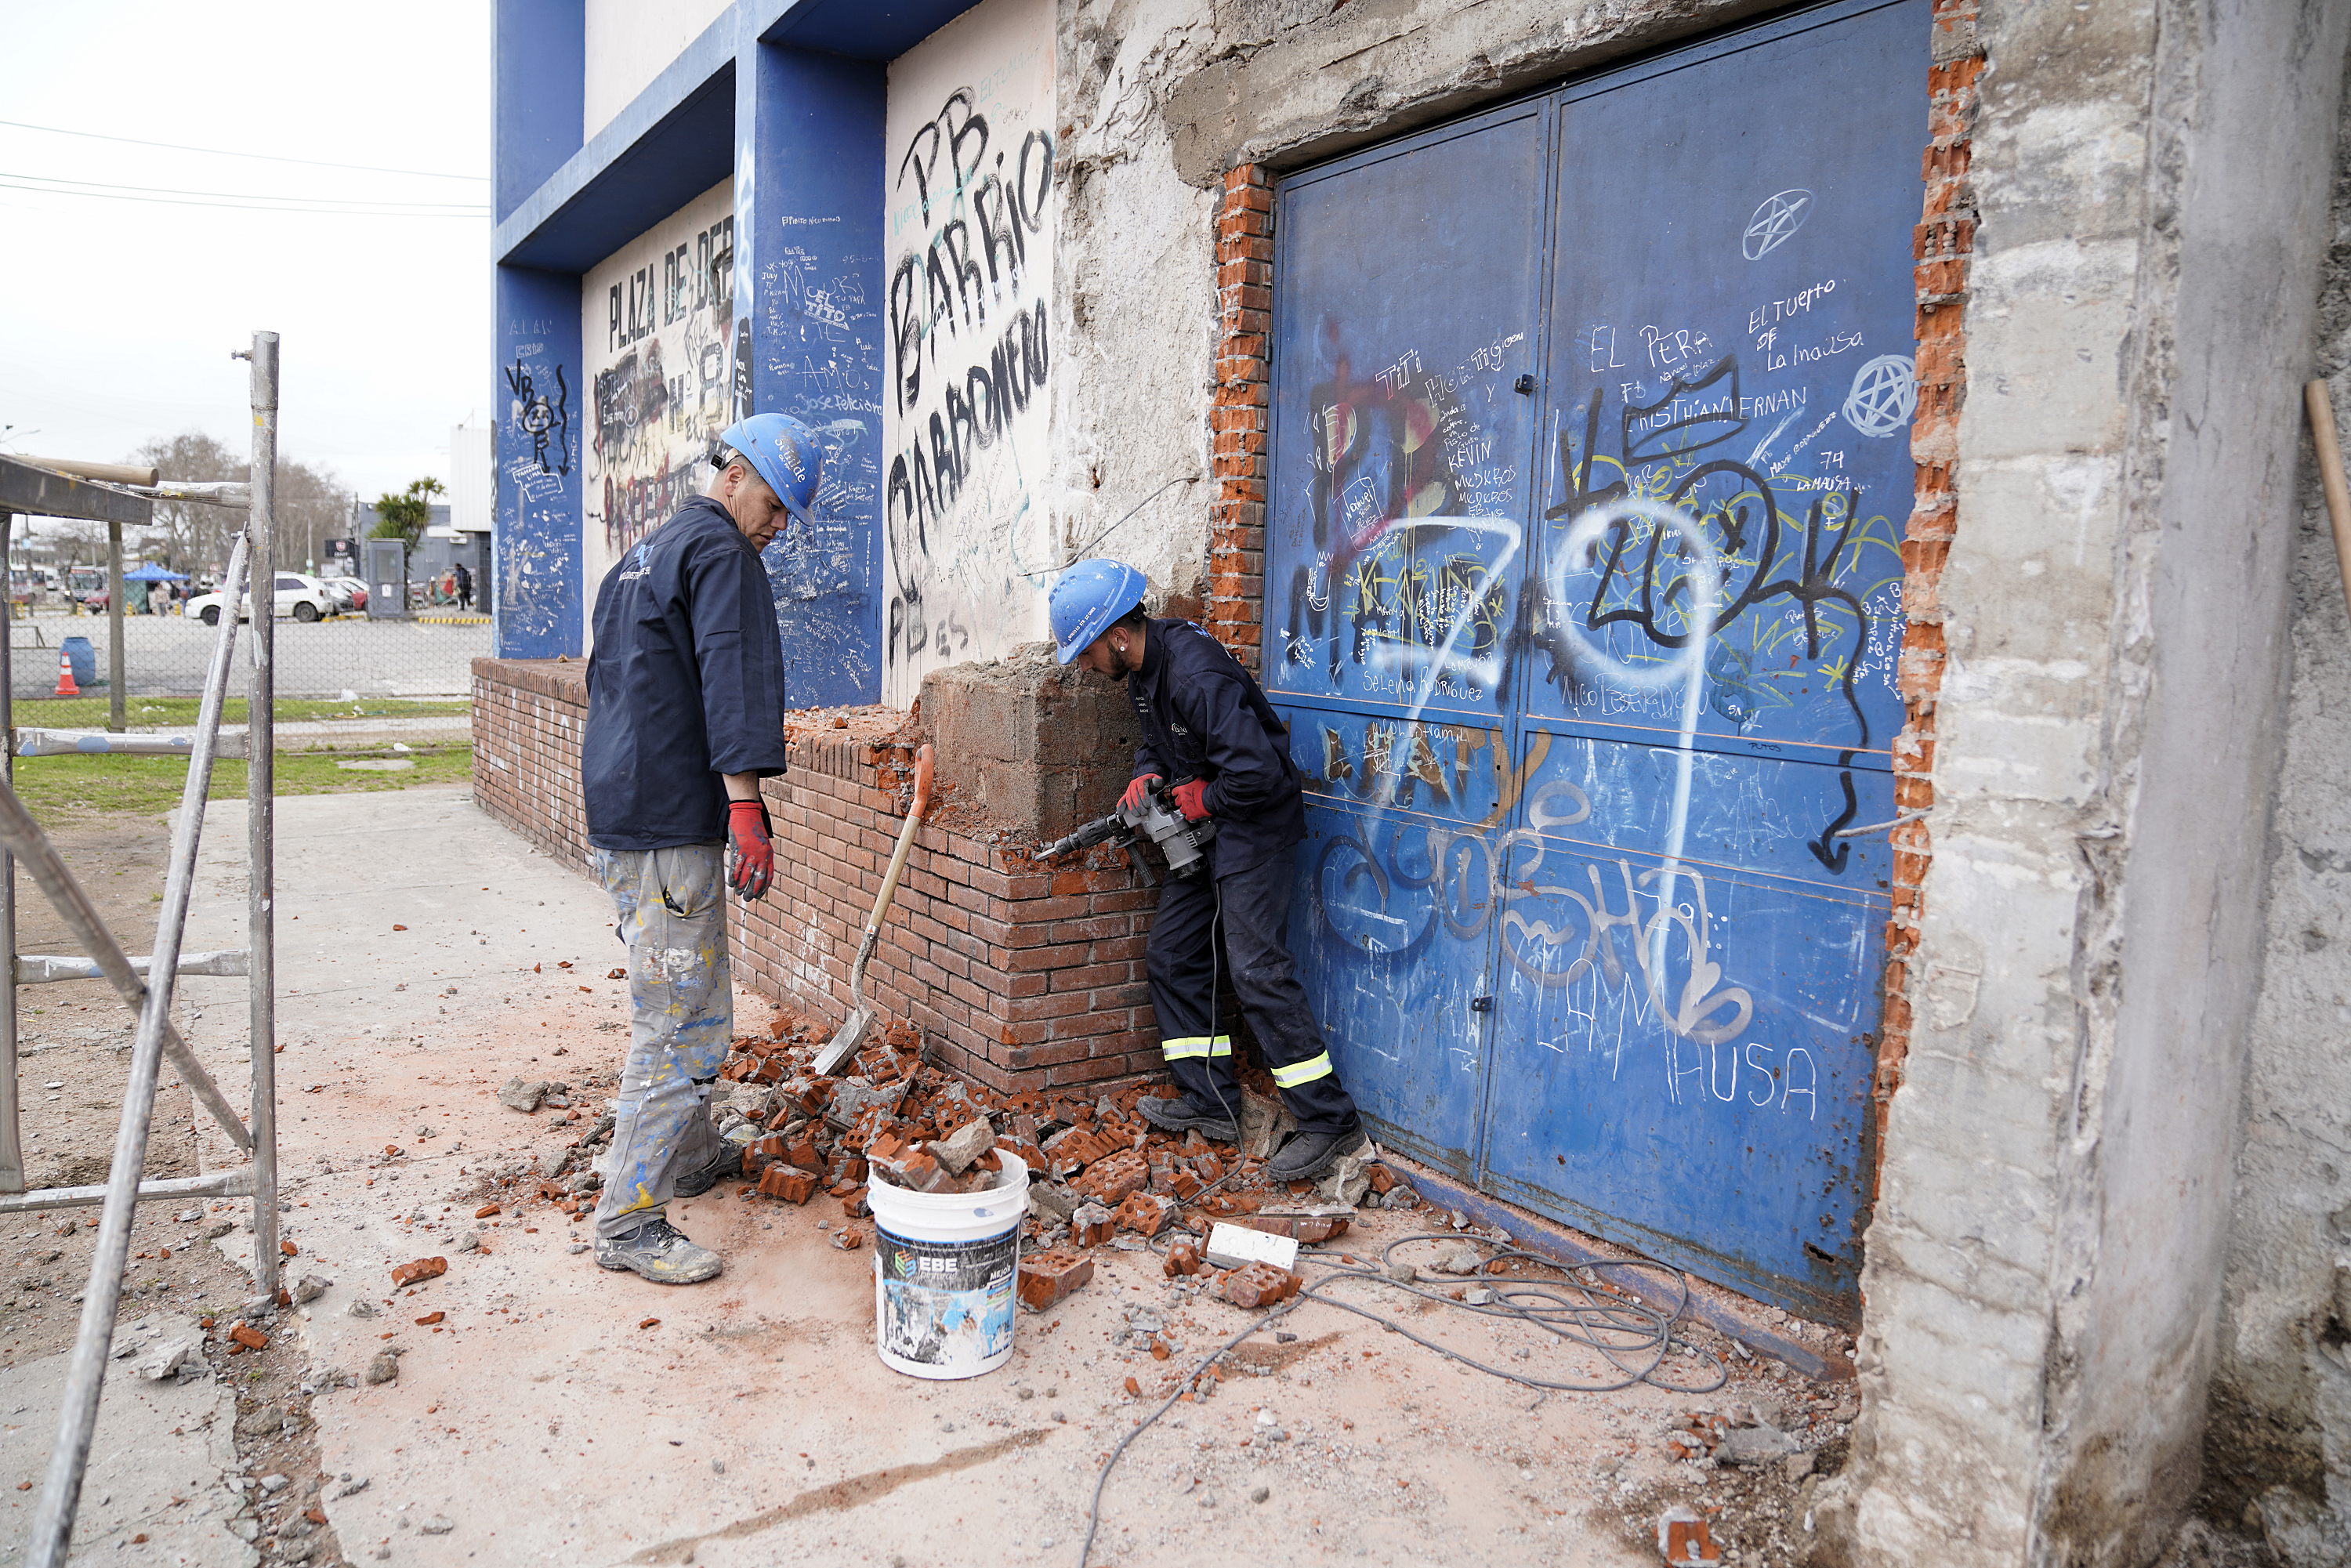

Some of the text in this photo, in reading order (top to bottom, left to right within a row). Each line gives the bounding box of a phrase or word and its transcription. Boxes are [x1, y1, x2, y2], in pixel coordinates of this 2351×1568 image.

[610, 263, 655, 353] PLAZA
[665, 241, 687, 328] DE
[1591, 324, 1713, 373] EL PERA
[1756, 326, 1777, 351] DE
[699, 340, 724, 425] 8
[888, 296, 1049, 602] CARBONERO
[1448, 440, 1491, 473] KEVIN
[515, 465, 539, 478] TAMARA
[919, 1256, 958, 1273] EBE
[990, 1264, 1012, 1281] MEJOR
